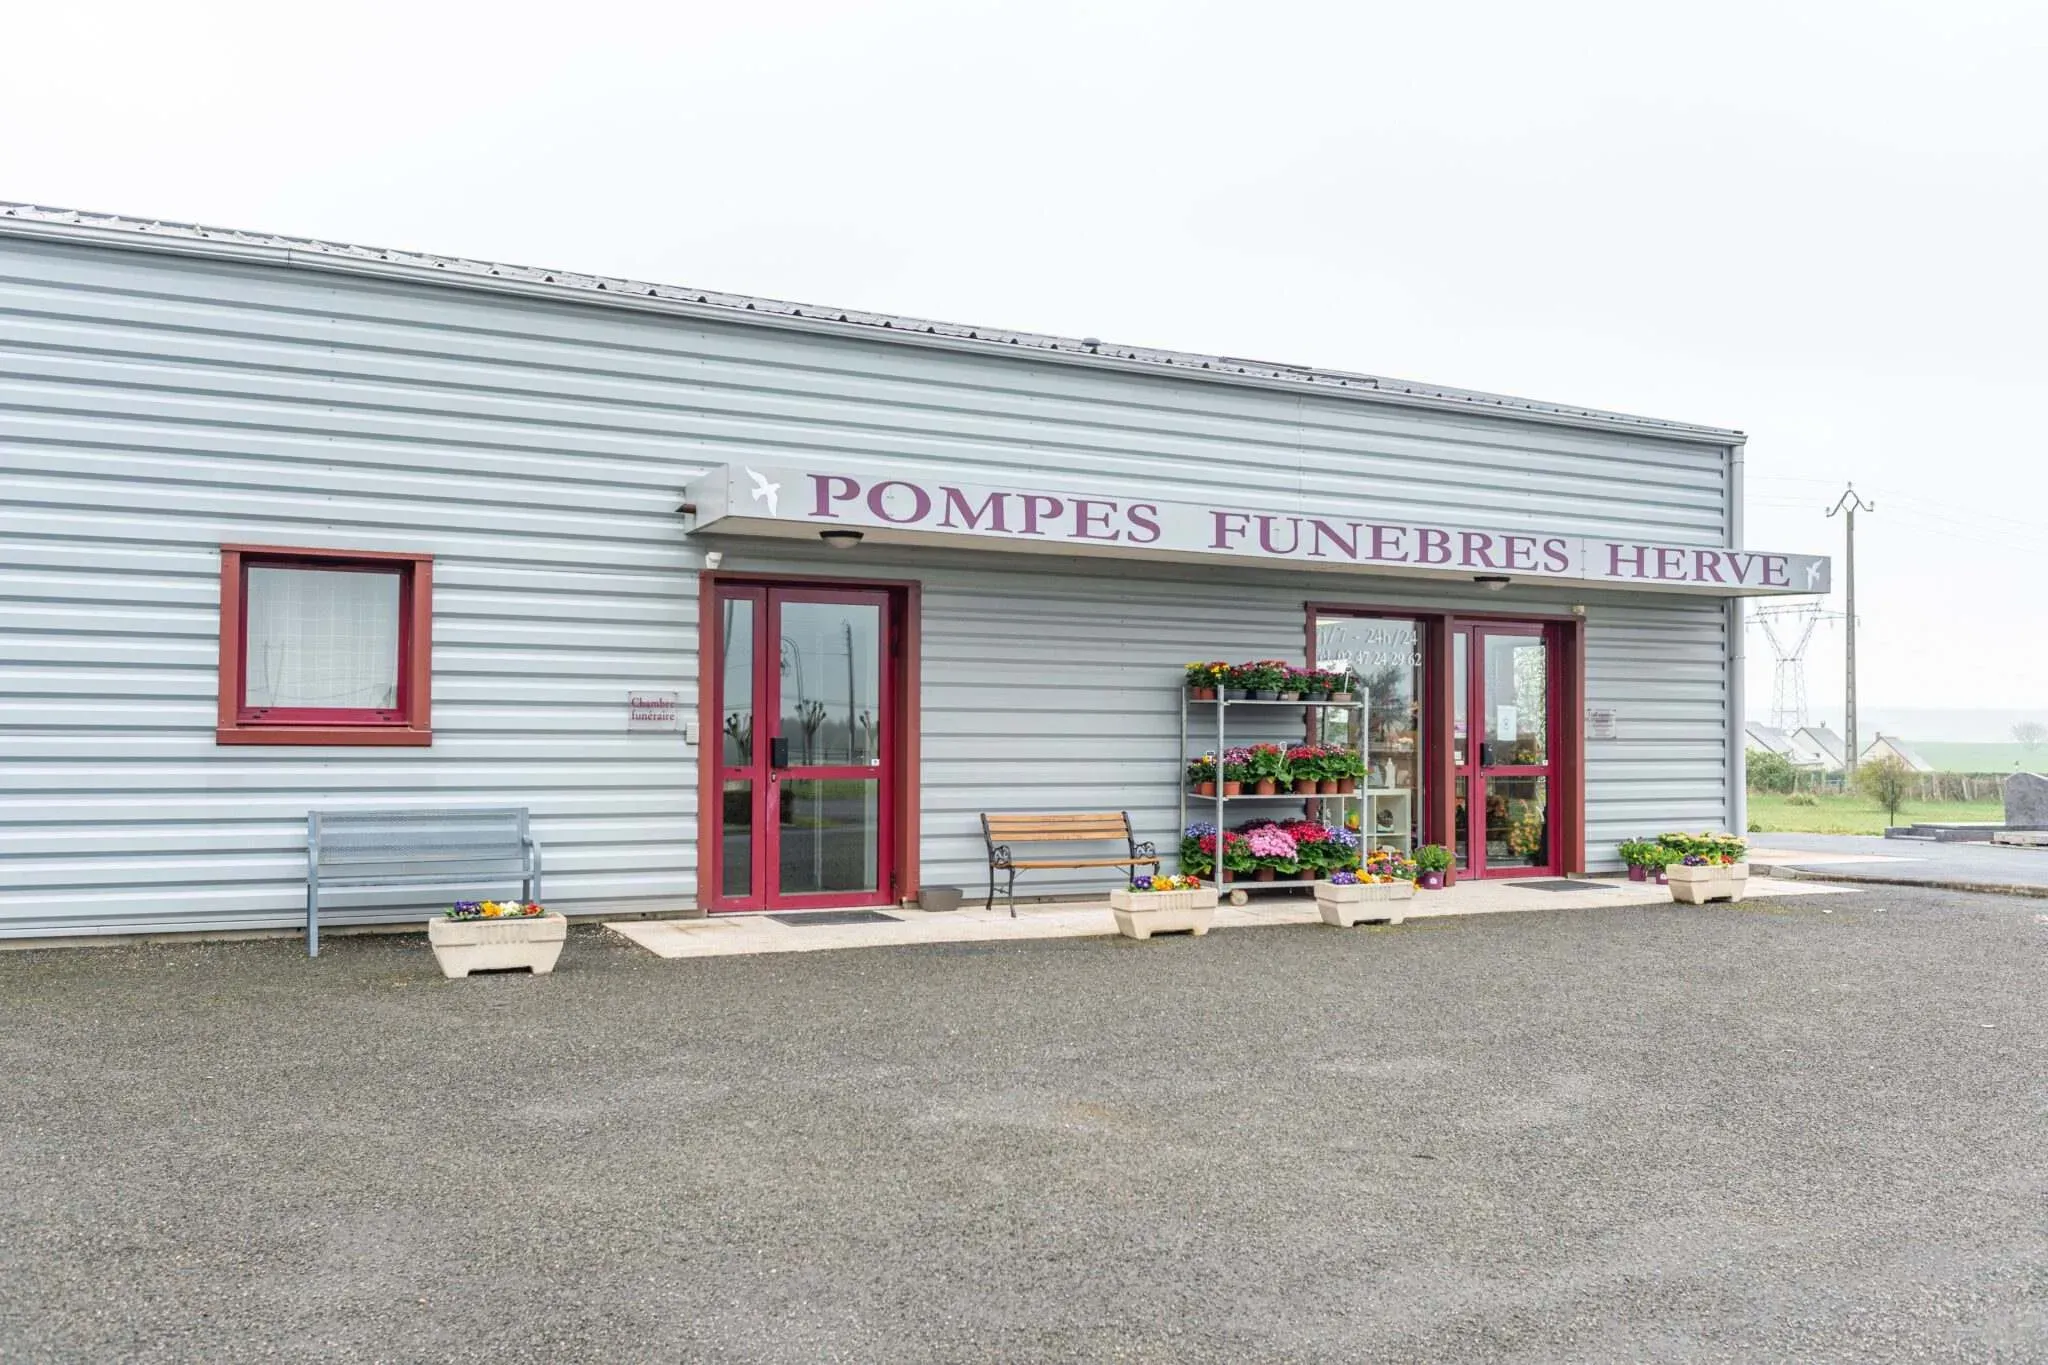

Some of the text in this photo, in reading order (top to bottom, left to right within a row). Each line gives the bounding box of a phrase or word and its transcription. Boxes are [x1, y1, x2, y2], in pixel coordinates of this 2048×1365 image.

[806, 473, 1791, 587] POMPES FUNEBRES HERVE
[1373, 651, 1386, 665] 24
[1391, 652, 1405, 666] 29
[1408, 652, 1422, 667] 62
[631, 697, 675, 708] Chambre
[631, 709, 676, 721] funéraire
